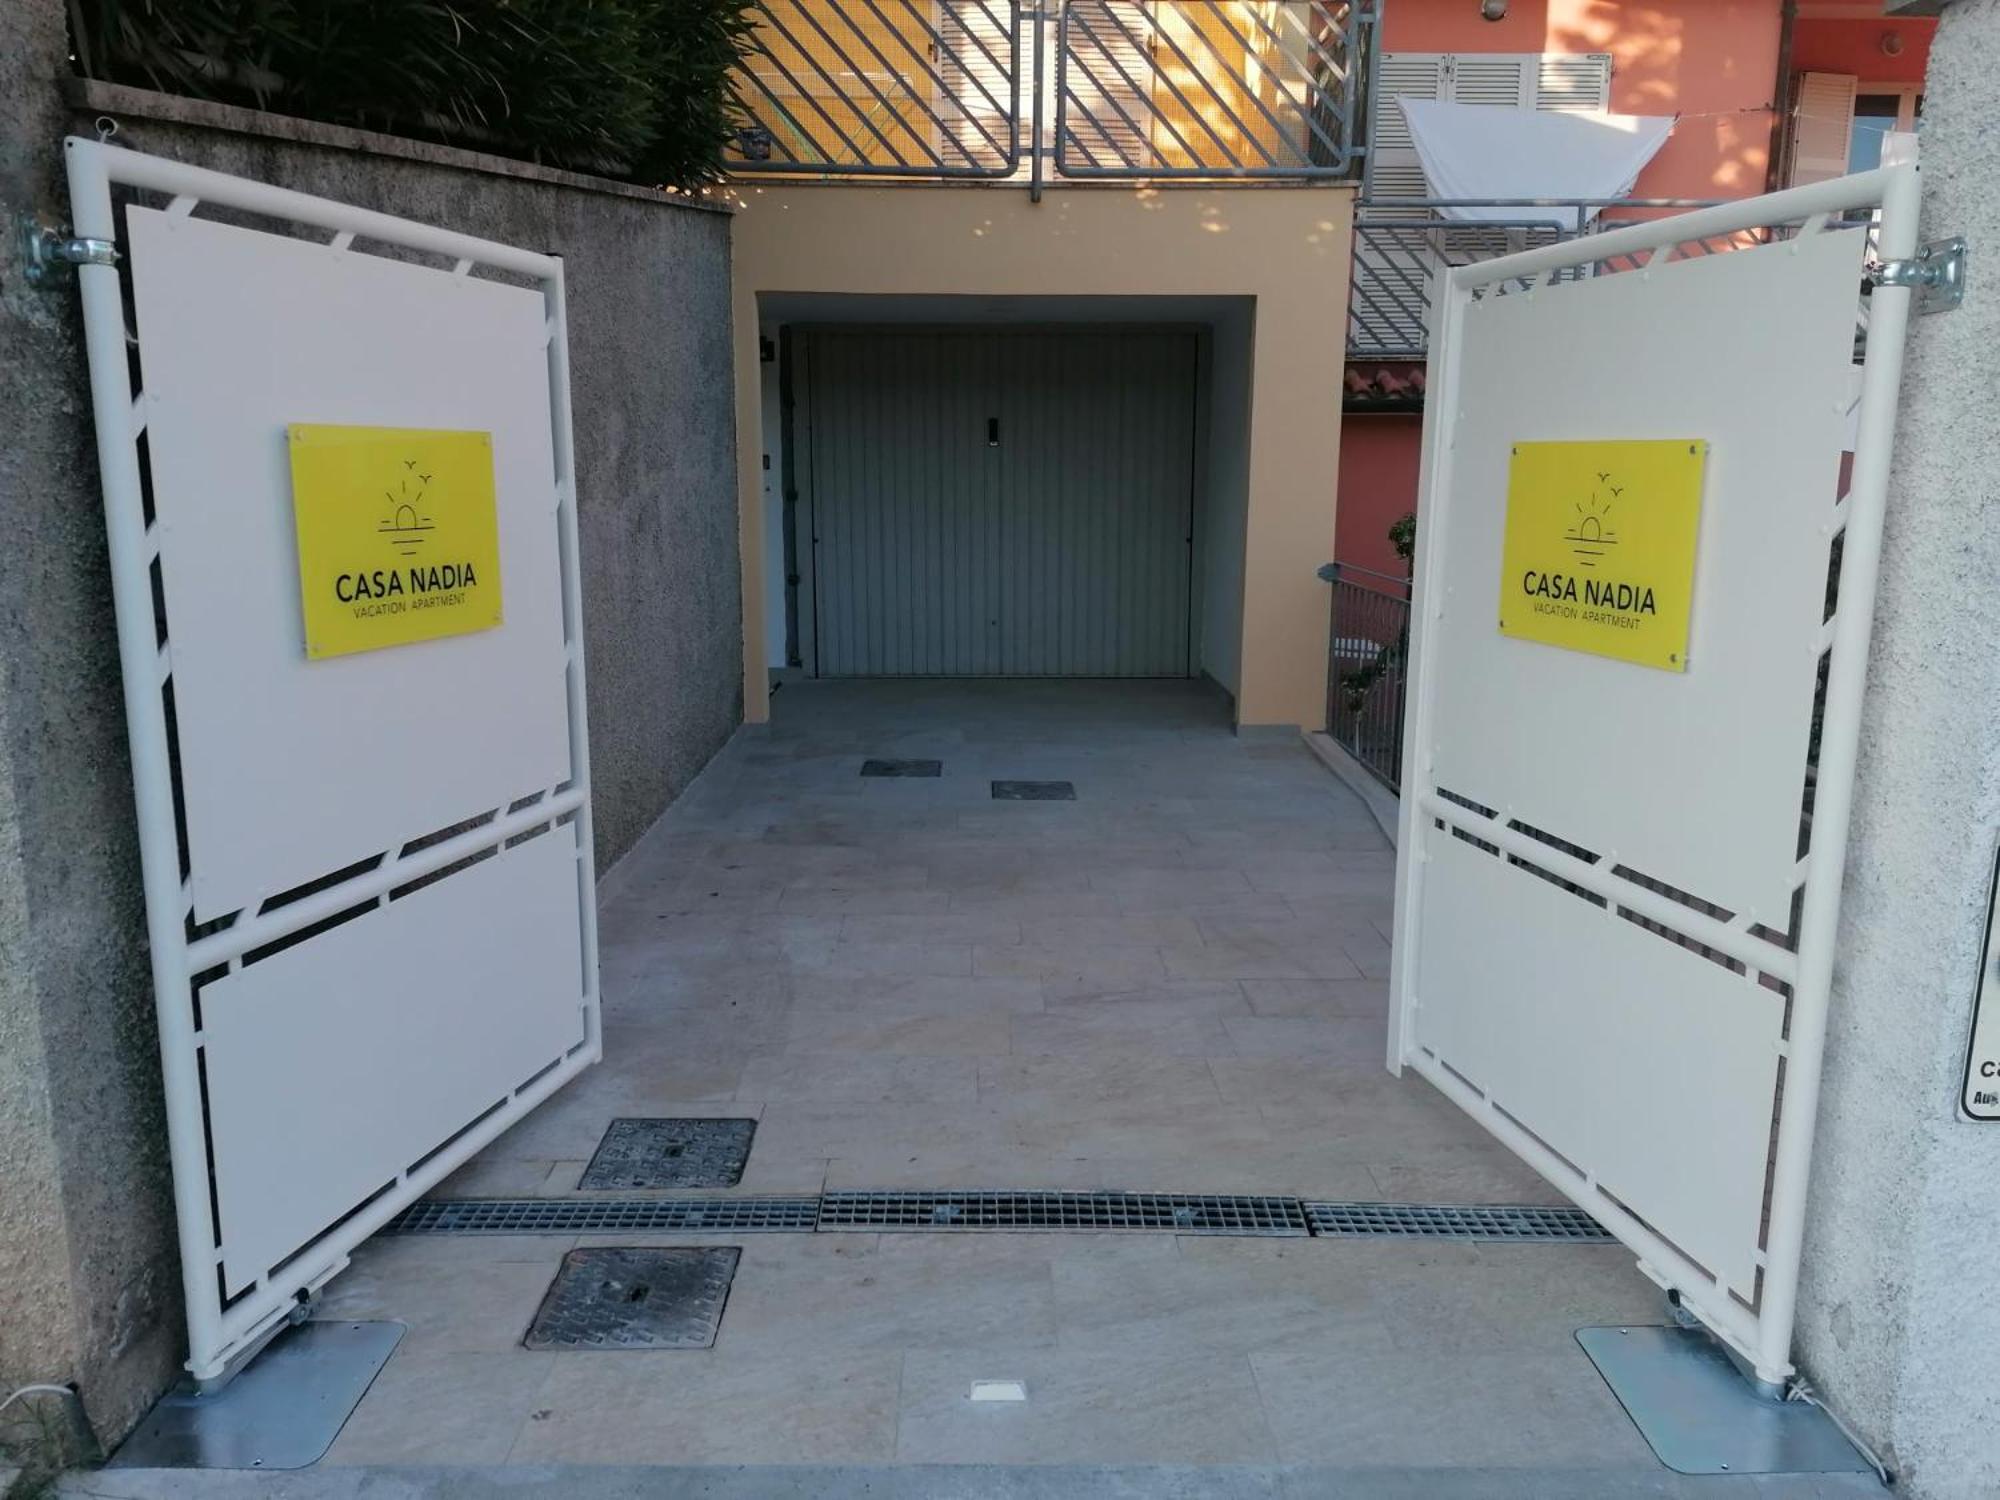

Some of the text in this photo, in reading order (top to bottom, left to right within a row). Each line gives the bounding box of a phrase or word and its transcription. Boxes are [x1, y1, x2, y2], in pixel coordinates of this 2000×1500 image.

[336, 563, 477, 602] CASA NADIA
[1523, 571, 1656, 615] CASA NADIA
[353, 593, 465, 619] VACATION APARTMENT
[1534, 602, 1641, 630] VACATION APARTMENT
